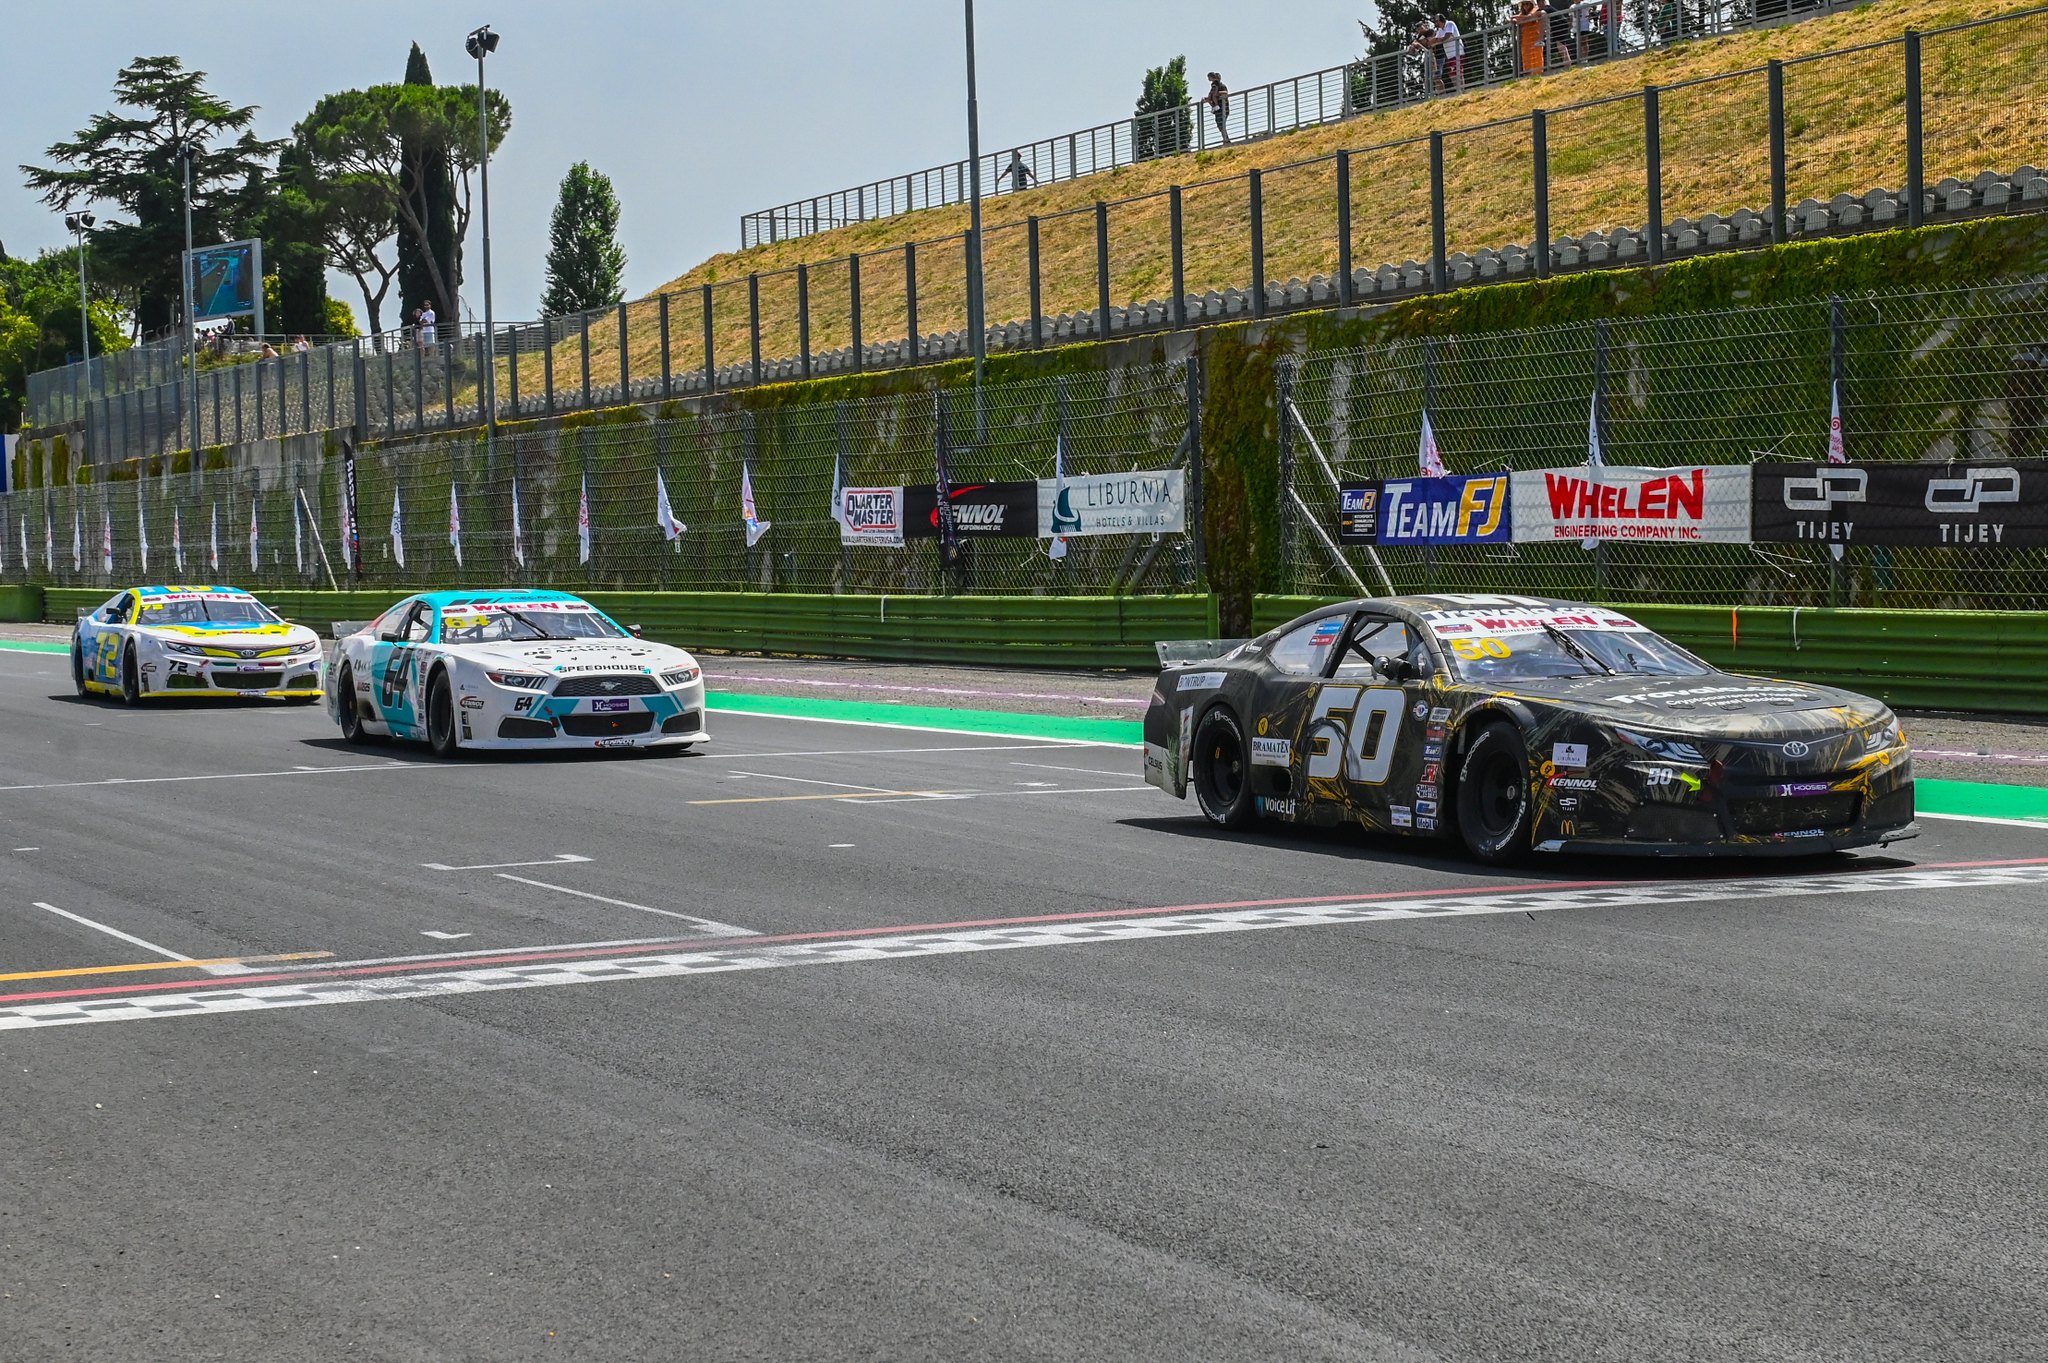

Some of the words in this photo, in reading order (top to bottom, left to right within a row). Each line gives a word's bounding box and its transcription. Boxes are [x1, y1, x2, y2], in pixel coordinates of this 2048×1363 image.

[1087, 479, 1171, 506] LIBURNIA
[1544, 468, 1704, 520] WHELEN
[847, 494, 893, 516] QUARTER
[951, 504, 1005, 524] ENNOL
[853, 509, 894, 526] MASTER
[1096, 517, 1126, 528] HOTELS
[1137, 515, 1166, 526] VILLAS
[1554, 525, 1618, 538] ENGINEERING
[1621, 525, 1675, 539] COMPANY
[1679, 526, 1702, 540] INC.
[1796, 521, 1854, 540] TIJEY
[1939, 524, 2004, 543] TIJEY
[96, 632, 119, 679] 72
[1450, 637, 1513, 661] 50
[169, 660, 189, 672] 72
[559, 664, 646, 674] SPEEDHOUSE
[382, 647, 414, 710] 64
[514, 696, 533, 711] 64
[1307, 685, 1407, 785] 50
[1549, 778, 1598, 789] KENNOL
[1646, 767, 1673, 785] 50
[1774, 828, 1825, 837] KENNOL
